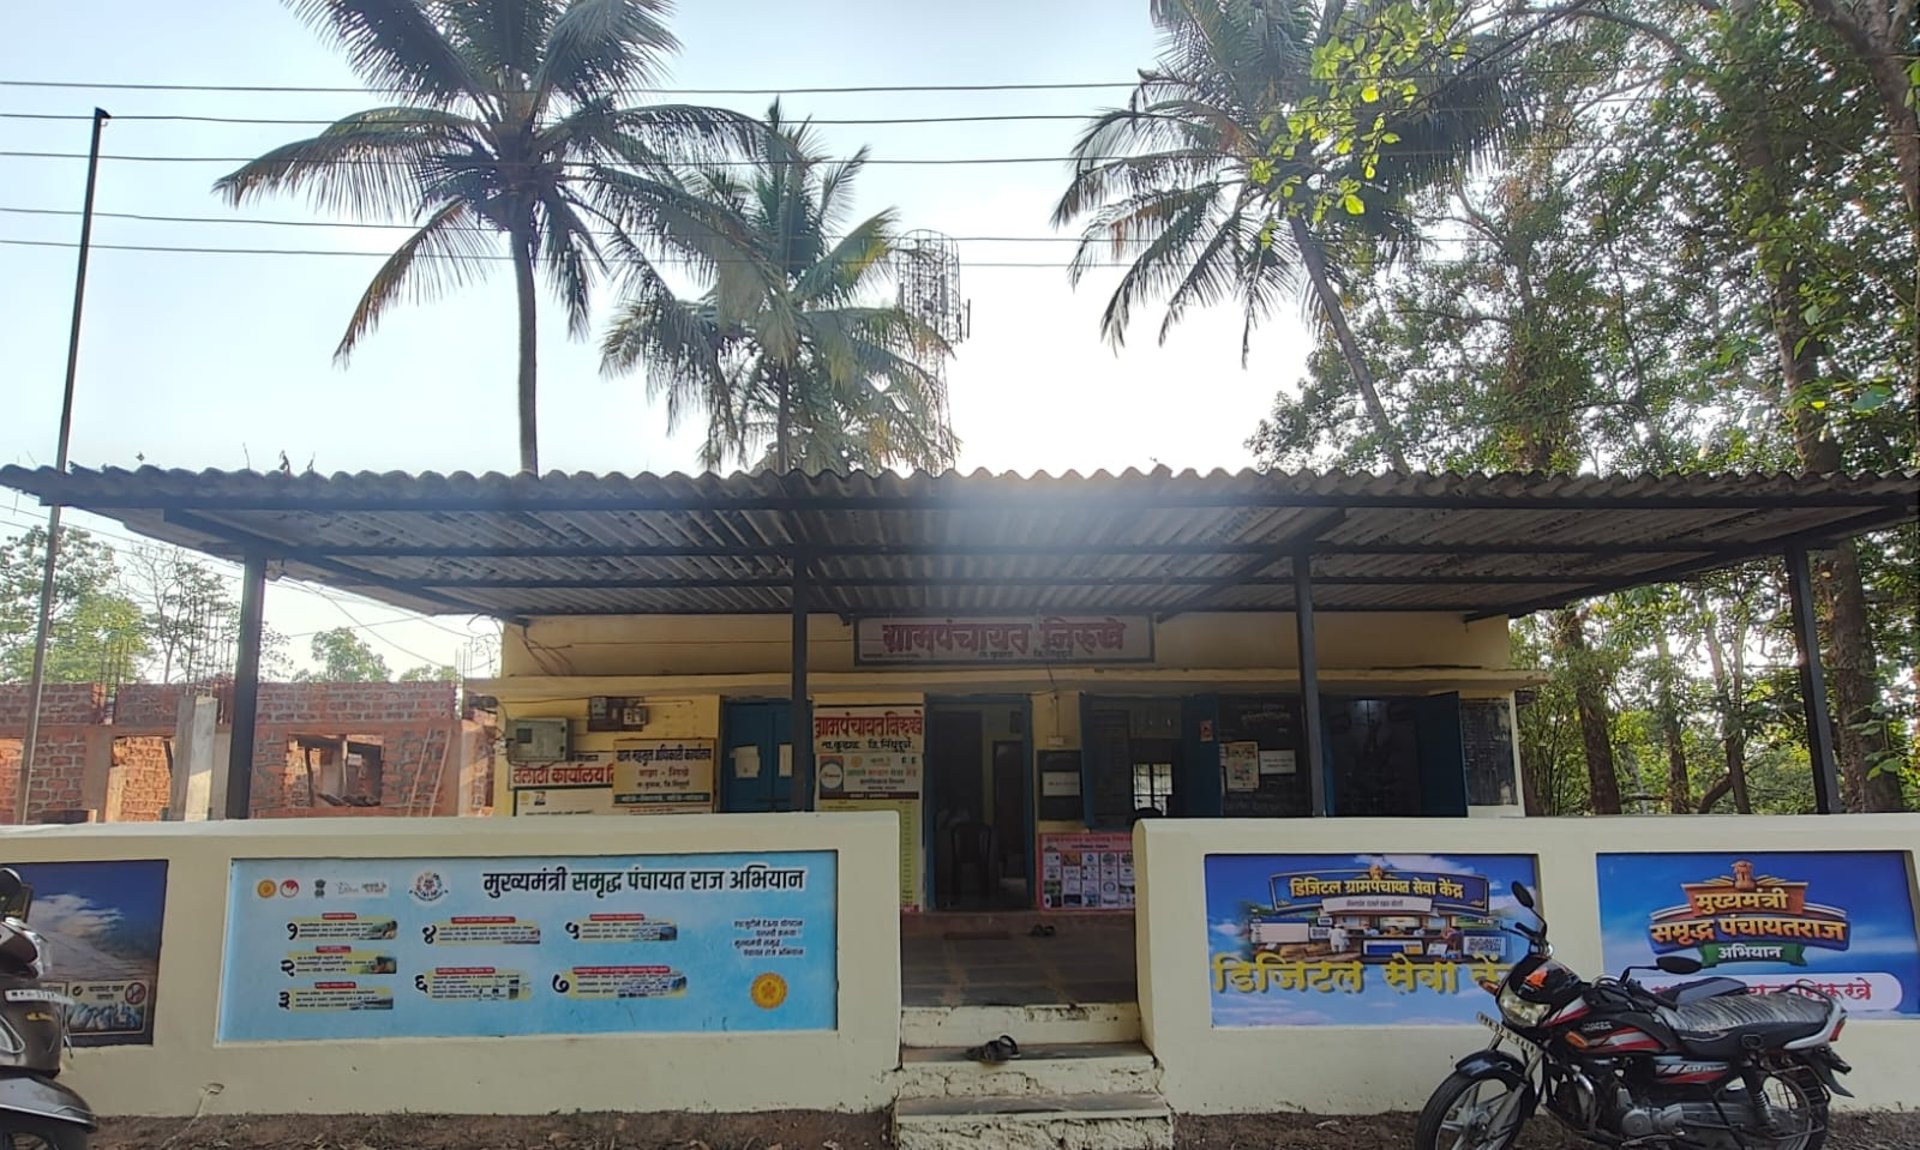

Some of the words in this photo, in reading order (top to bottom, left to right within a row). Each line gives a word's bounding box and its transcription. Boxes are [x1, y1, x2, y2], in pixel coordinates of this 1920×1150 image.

[883, 618, 1031, 655] ग्रामपंचायत
[551, 763, 604, 783] कार्यालय
[483, 866, 567, 898] मुख्यमंत्री
[572, 871, 622, 898] समृद्ध
[628, 867, 684, 891] पंचायत
[690, 870, 724, 890] राज
[729, 865, 805, 890] अभियान
[1290, 877, 1341, 897] डिजिटल
[1413, 879, 1437, 896] सेवा
[1439, 878, 1464, 899] केंद्र
[1696, 888, 1788, 915] मुख्यमंत्री
[1650, 921, 1716, 945] समृद्ध
[1717, 946, 1783, 960] अभियान
[281, 959, 295, 977] २
[1211, 952, 1364, 993] डिजिटल
[1382, 952, 1460, 994] सेवा
[415, 974, 428, 994] ६
[552, 974, 570, 993] ७
[278, 991, 290, 1010] ३
